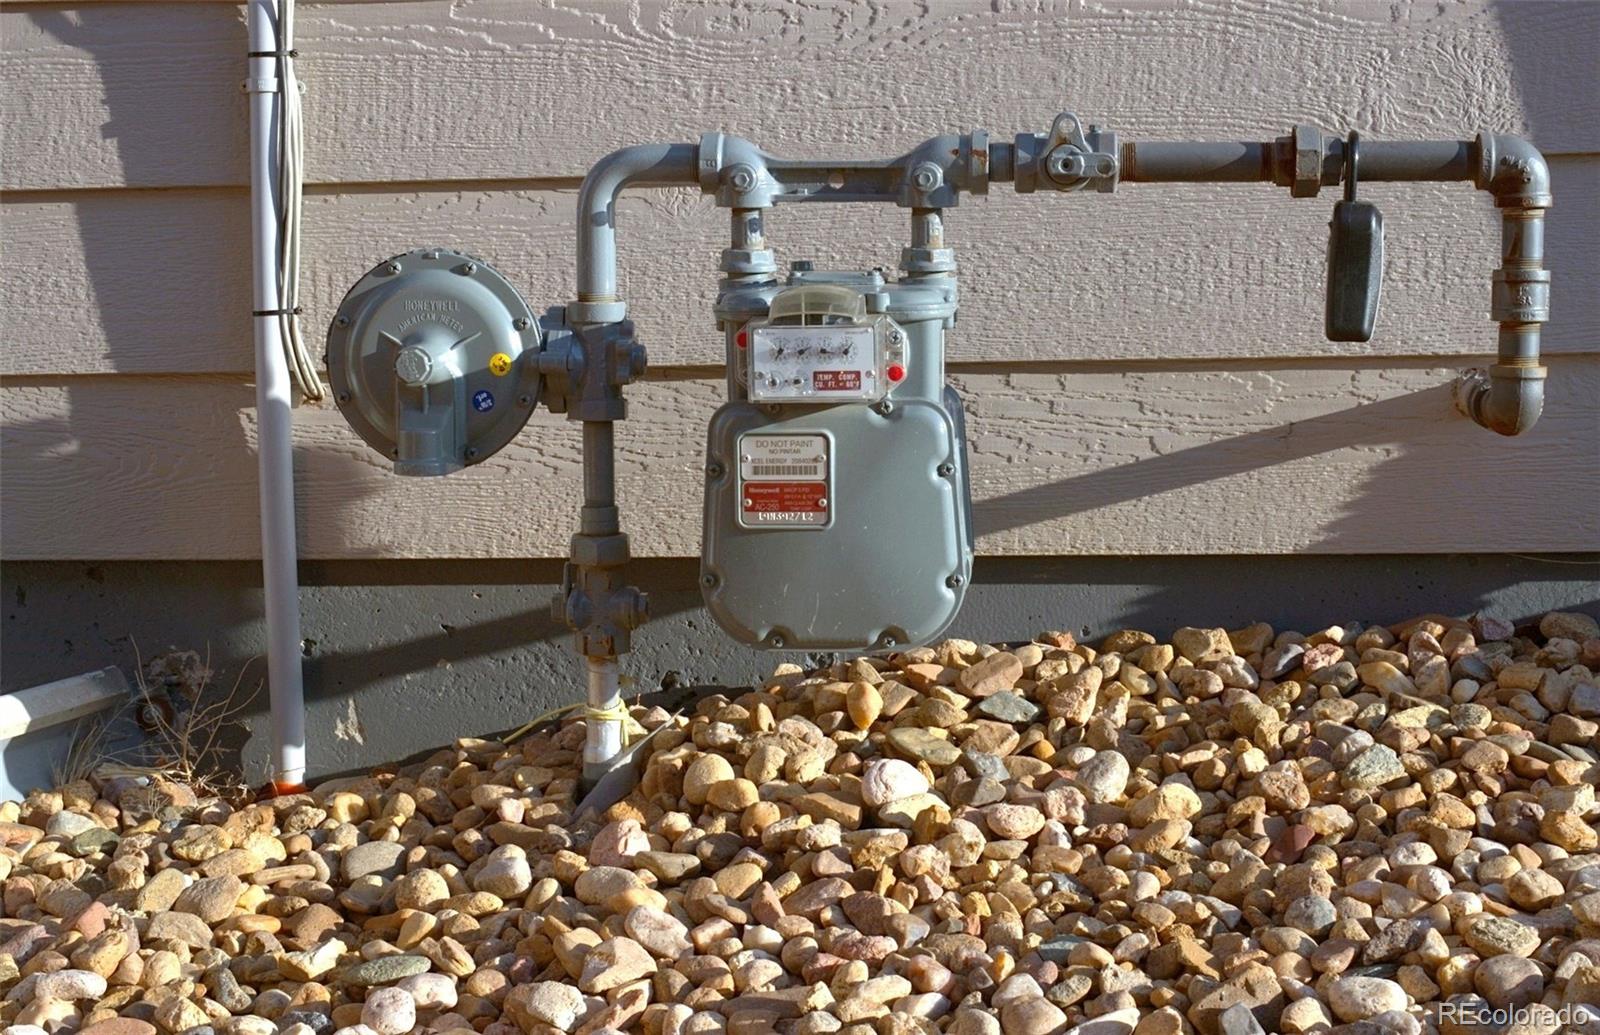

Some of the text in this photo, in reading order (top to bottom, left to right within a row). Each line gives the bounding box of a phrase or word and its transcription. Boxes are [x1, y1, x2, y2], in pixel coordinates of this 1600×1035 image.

[404, 300, 459, 311] HONEYWELL
[398, 313, 436, 332] AMERICAN
[755, 440, 814, 448] DO NOT PAINT
[754, 503, 780, 511] AC-250
